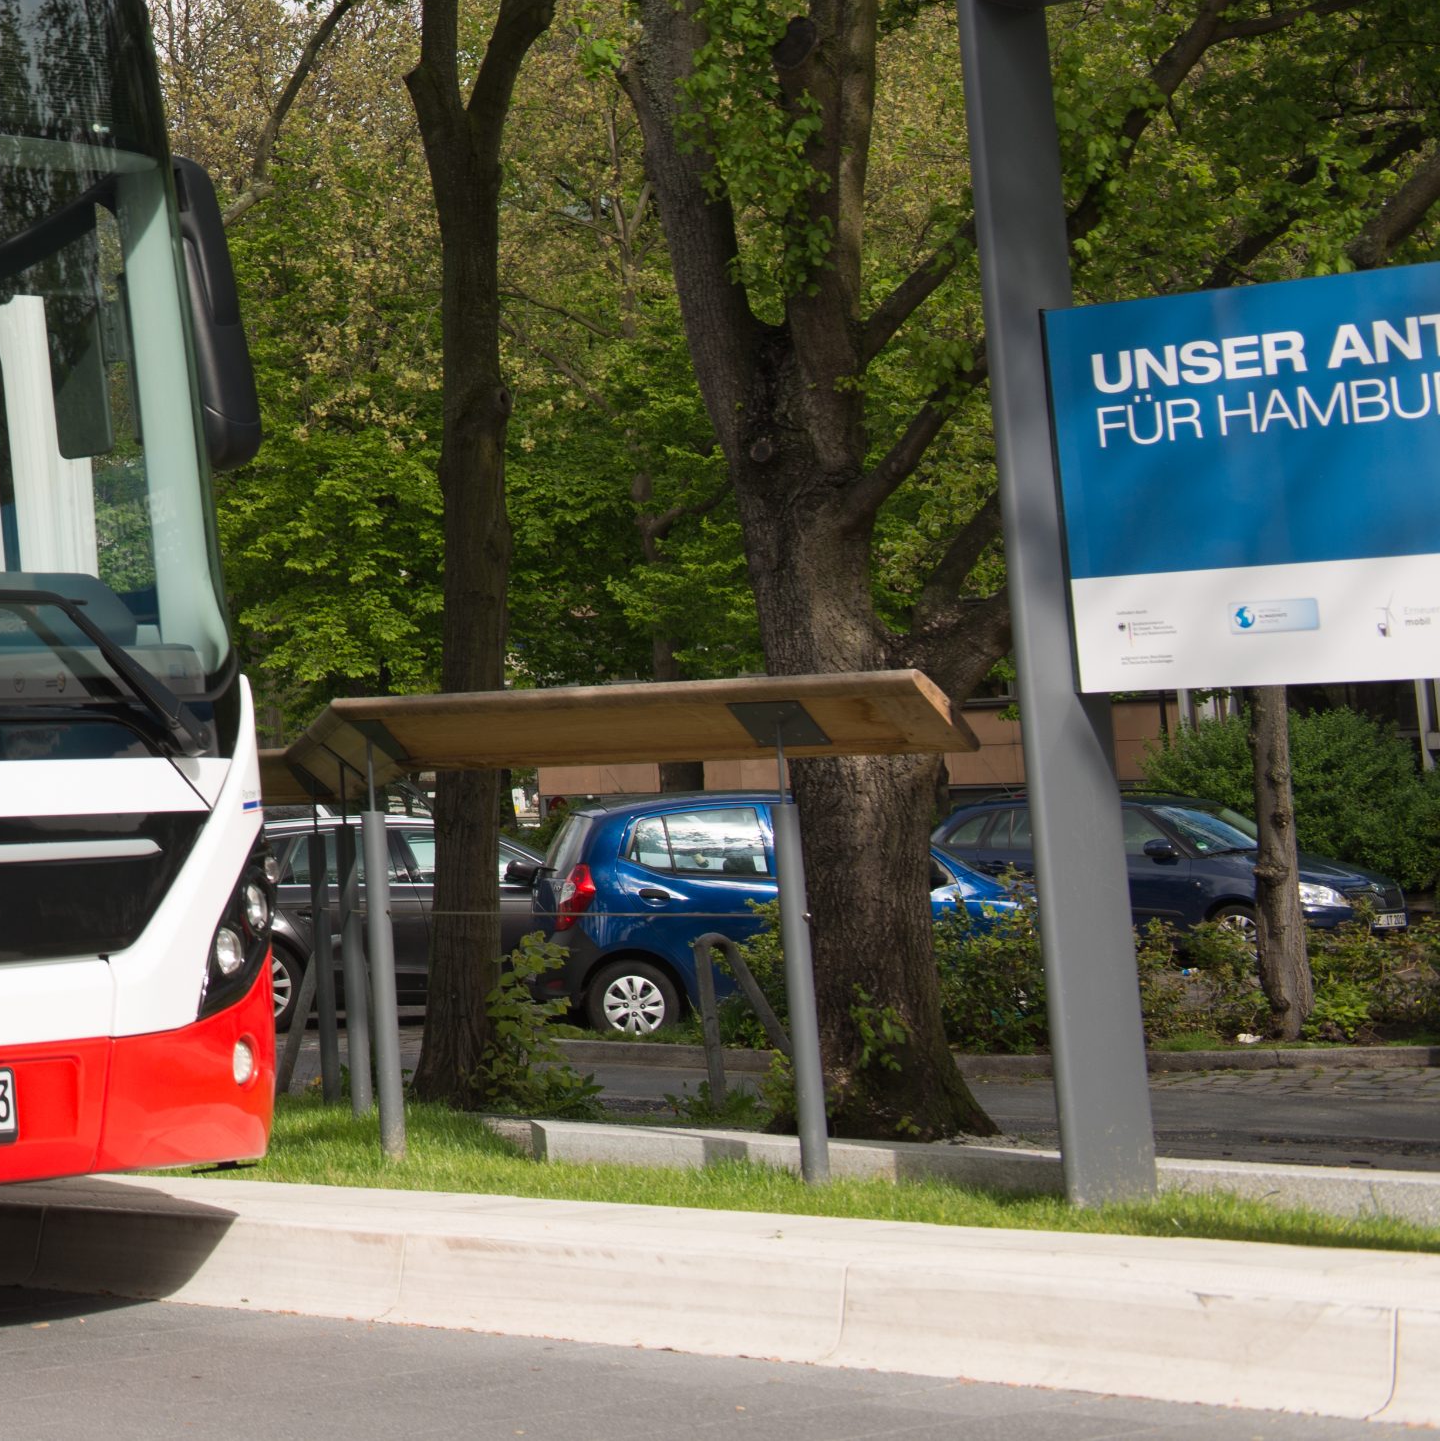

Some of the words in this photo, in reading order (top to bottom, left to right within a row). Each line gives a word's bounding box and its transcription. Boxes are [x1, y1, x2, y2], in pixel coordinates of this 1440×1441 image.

[1091, 330, 1307, 394] UNSER
[1327, 313, 1440, 369] ANT
[1096, 393, 1204, 448] FÜR
[1217, 375, 1440, 436] HAMBU
